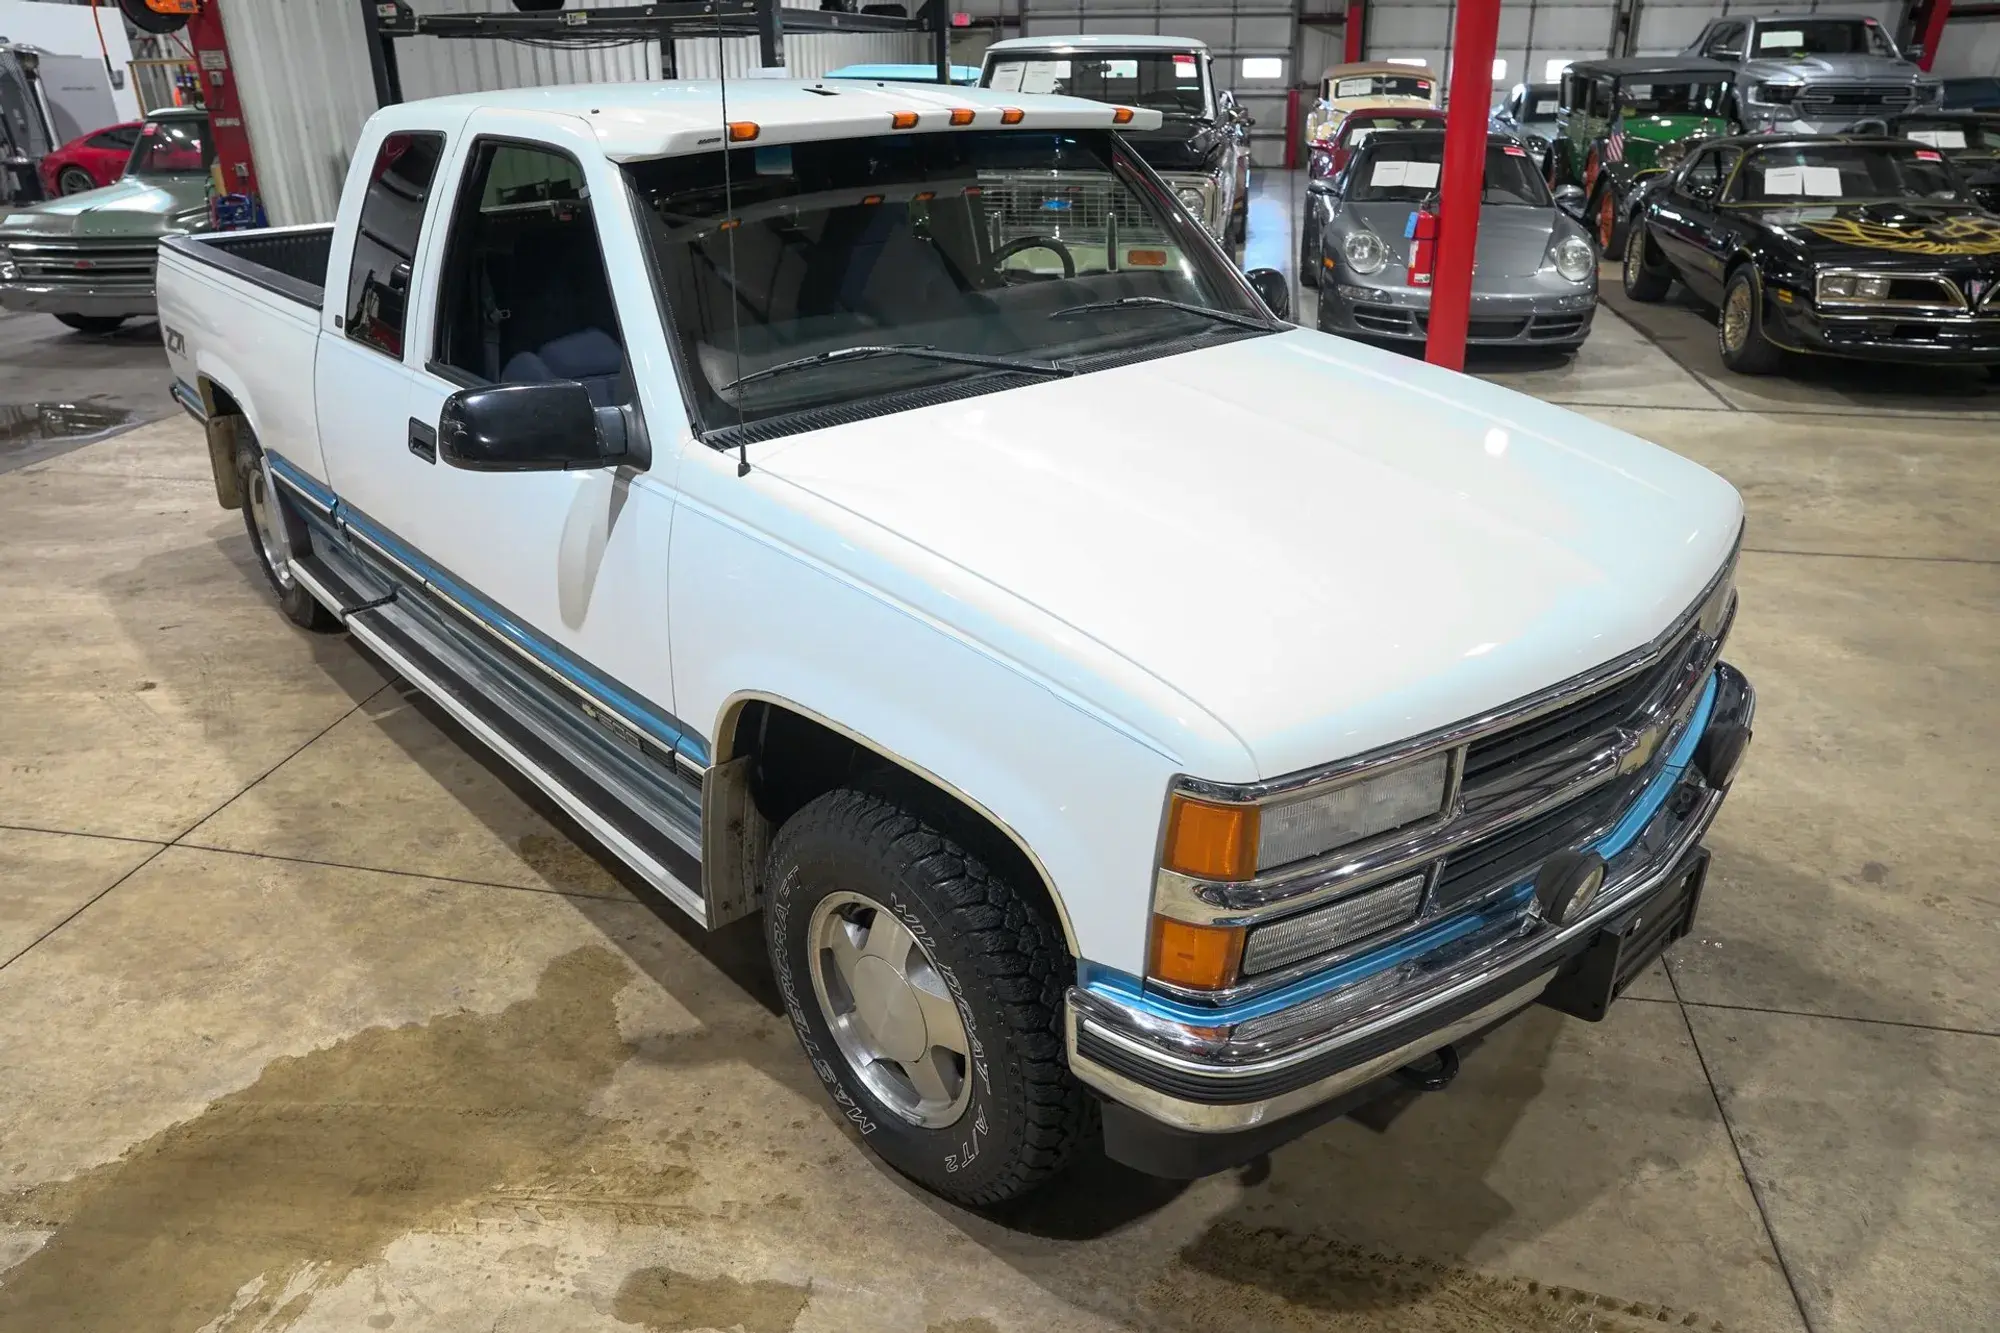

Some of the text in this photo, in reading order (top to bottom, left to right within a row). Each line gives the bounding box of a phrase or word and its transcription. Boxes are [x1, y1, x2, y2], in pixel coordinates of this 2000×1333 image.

[165, 325, 186, 354] Z71
[773, 865, 877, 1136] MASTERCRAFT
[890, 891, 992, 1096] WILDCAT
